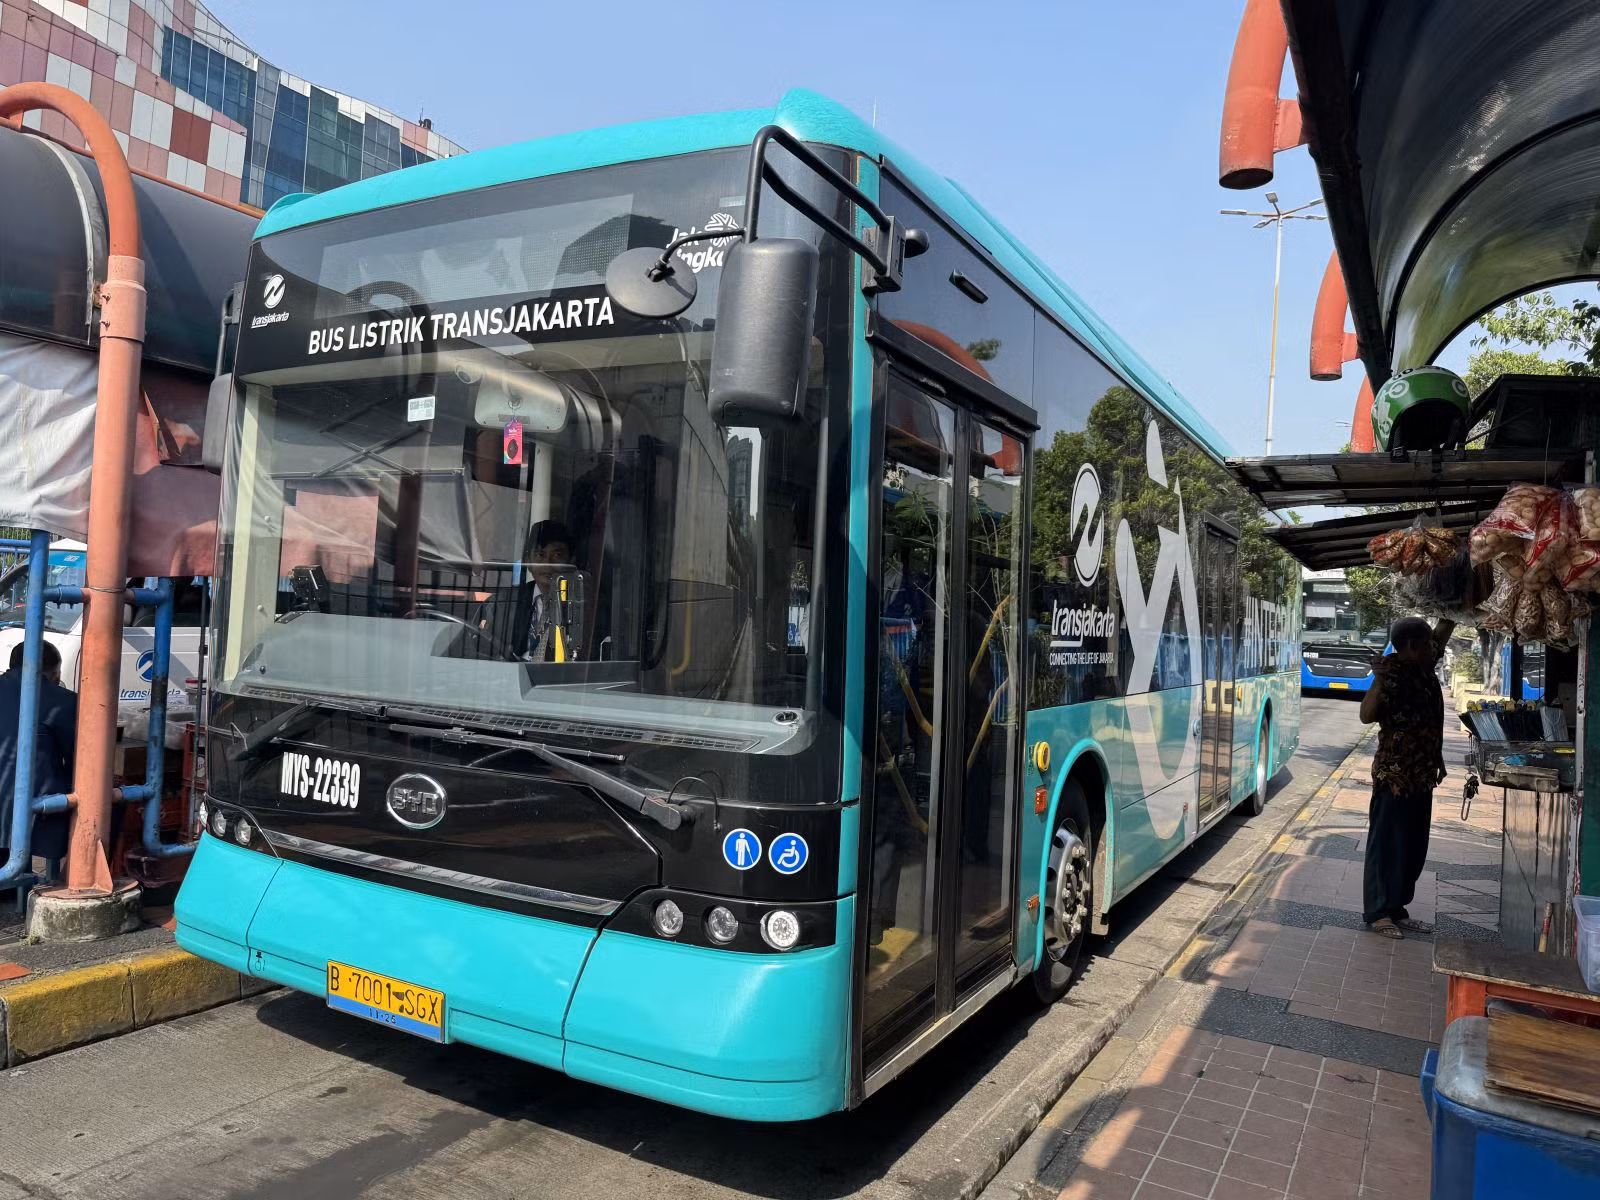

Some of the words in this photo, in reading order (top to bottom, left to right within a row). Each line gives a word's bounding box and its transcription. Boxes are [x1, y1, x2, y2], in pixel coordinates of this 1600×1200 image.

[308, 327, 344, 354] BUS
[348, 315, 426, 350] LISTRIK
[430, 296, 615, 339] TRANSJAKARTA
[1050, 599, 1116, 648] transjakarta
[1049, 652, 1077, 666] CONNECTING
[1077, 652, 1085, 665] THE
[281, 751, 361, 809] MYS-22339
[393, 787, 439, 815] BYD
[331, 966, 340, 991] B
[405, 989, 439, 1024] SGX
